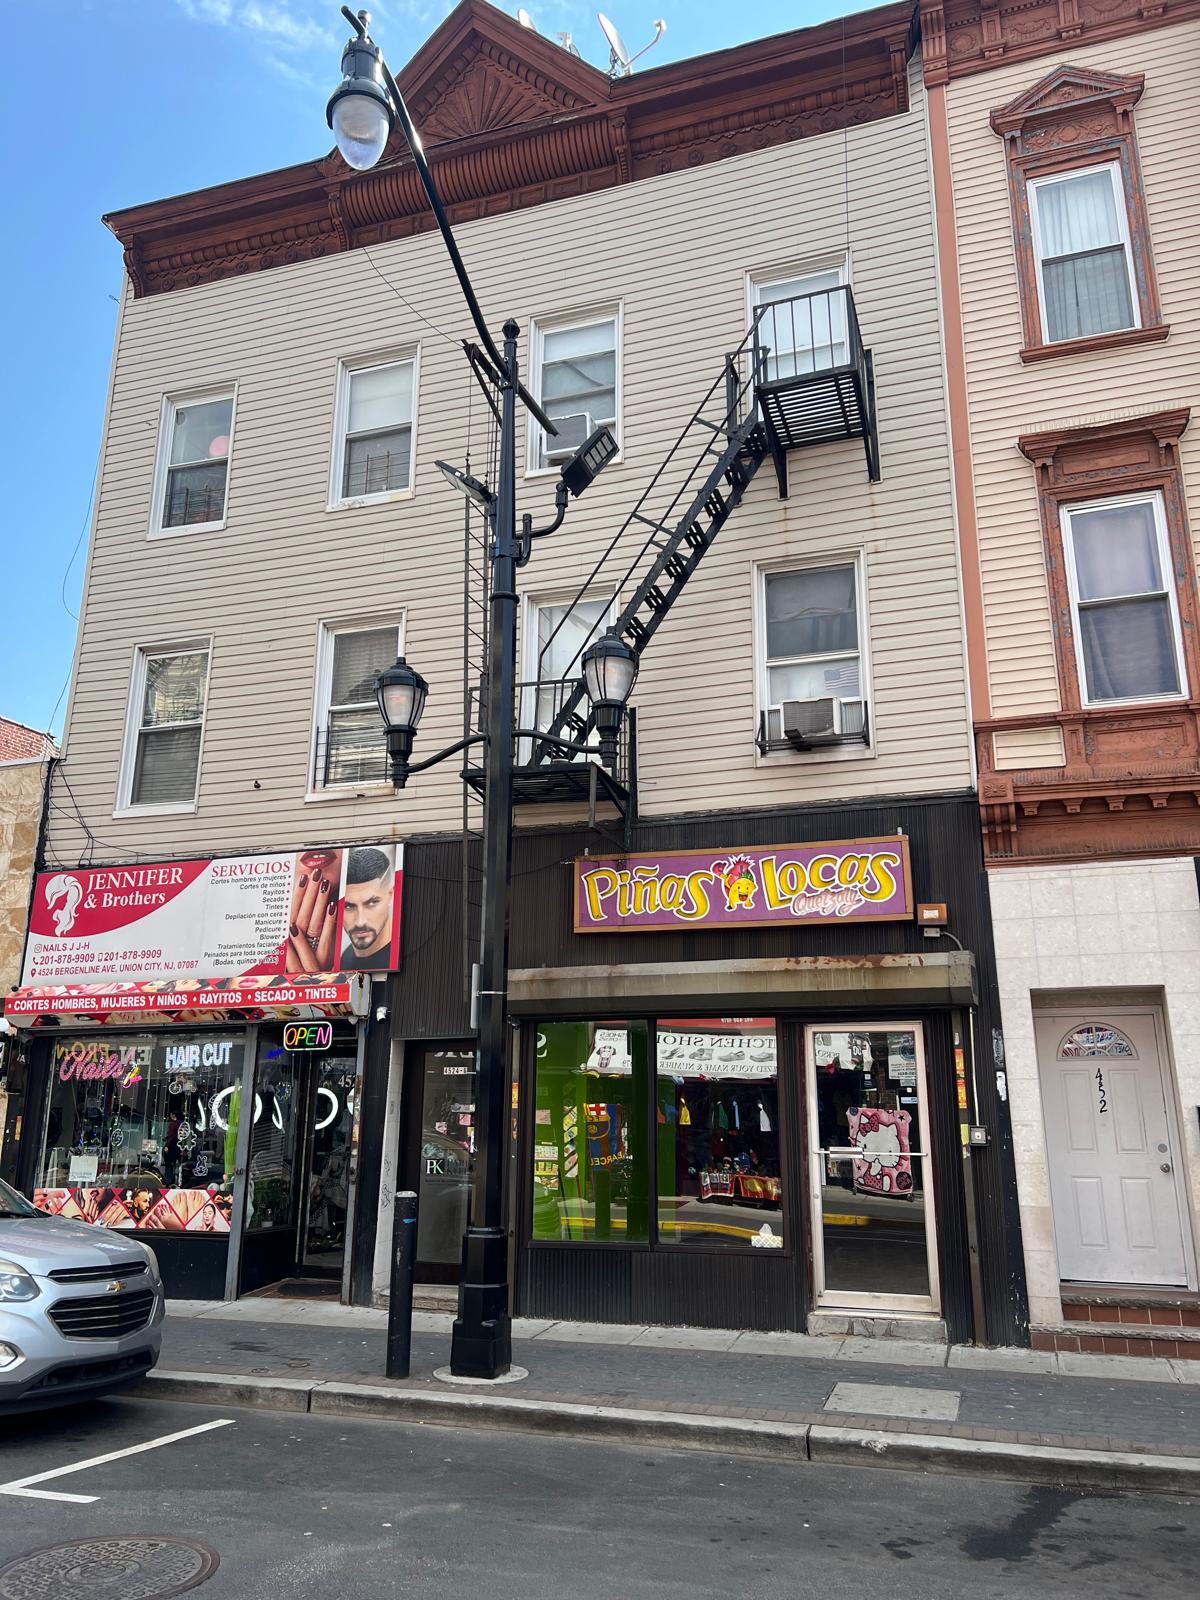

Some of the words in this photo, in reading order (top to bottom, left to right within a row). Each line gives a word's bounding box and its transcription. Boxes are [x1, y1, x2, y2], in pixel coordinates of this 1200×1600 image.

[211, 861, 290, 877] SERVICIOS
[86, 867, 183, 893] JENNIFER
[760, 852, 900, 911] Locas
[84, 893, 97, 909] &
[102, 892, 166, 908] Brothers
[43, 943, 67, 952] NAILS
[40, 953, 95, 965] 201-878-9909
[104, 949, 162, 961] 201-878-9909
[38, 968, 53, 976] 4524
[55, 965, 100, 975] BERGENLINE
[119, 962, 142, 972] UNION
[144, 961, 162, 971] CITY,
[177, 960, 199, 969] 07087
[199, 992, 242, 1004] RAYITOS
[254, 989, 296, 1001] SECADO
[304, 987, 337, 999] TINTES
[14, 999, 50, 1011] CORTES
[51, 997, 99, 1010] HOMBRES,
[101, 995, 146, 1008] MUJERES
[147, 995, 155, 1006] Y
[157, 992, 188, 1006] NIÑOS
[285, 1026, 331, 1046] OPEN
[165, 1044, 200, 1069] HAIR
[202, 1042, 232, 1067] CUT
